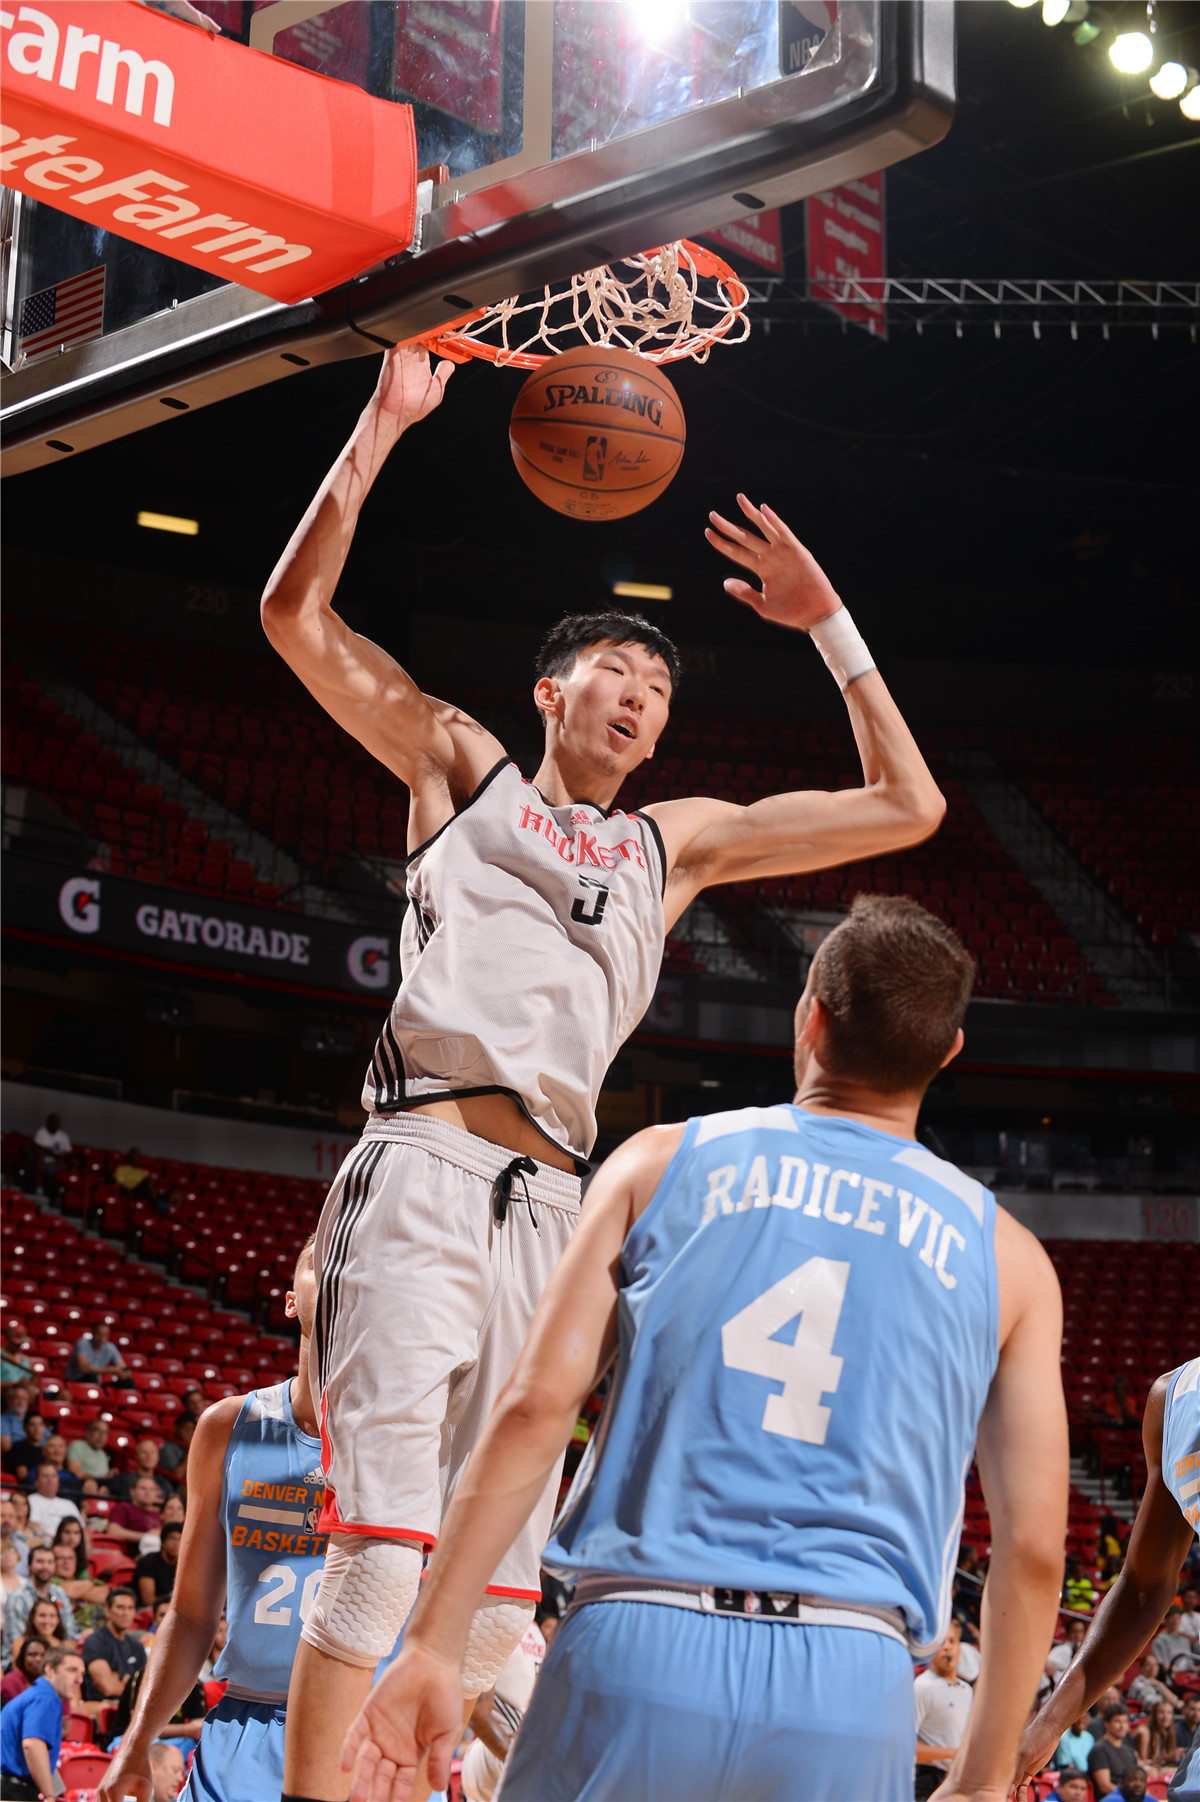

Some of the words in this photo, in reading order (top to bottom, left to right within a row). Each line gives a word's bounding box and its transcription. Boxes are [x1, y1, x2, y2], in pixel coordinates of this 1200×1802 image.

[0, 6, 175, 128] arm
[69, 169, 312, 274] Farm
[544, 385, 663, 428] SPALDING
[186, 584, 228, 616] 230
[1153, 674, 1194, 699] 232
[59, 877, 100, 934] G
[135, 904, 311, 965] GATORADE
[347, 935, 389, 989] G
[312, 1139, 356, 1175] 11
[702, 1155, 967, 1290] RADICEVIC
[1141, 1203, 1192, 1235] 120
[721, 1255, 852, 1446] 4
[242, 1480, 308, 1506] DENVER
[231, 1525, 330, 1557] BASKET
